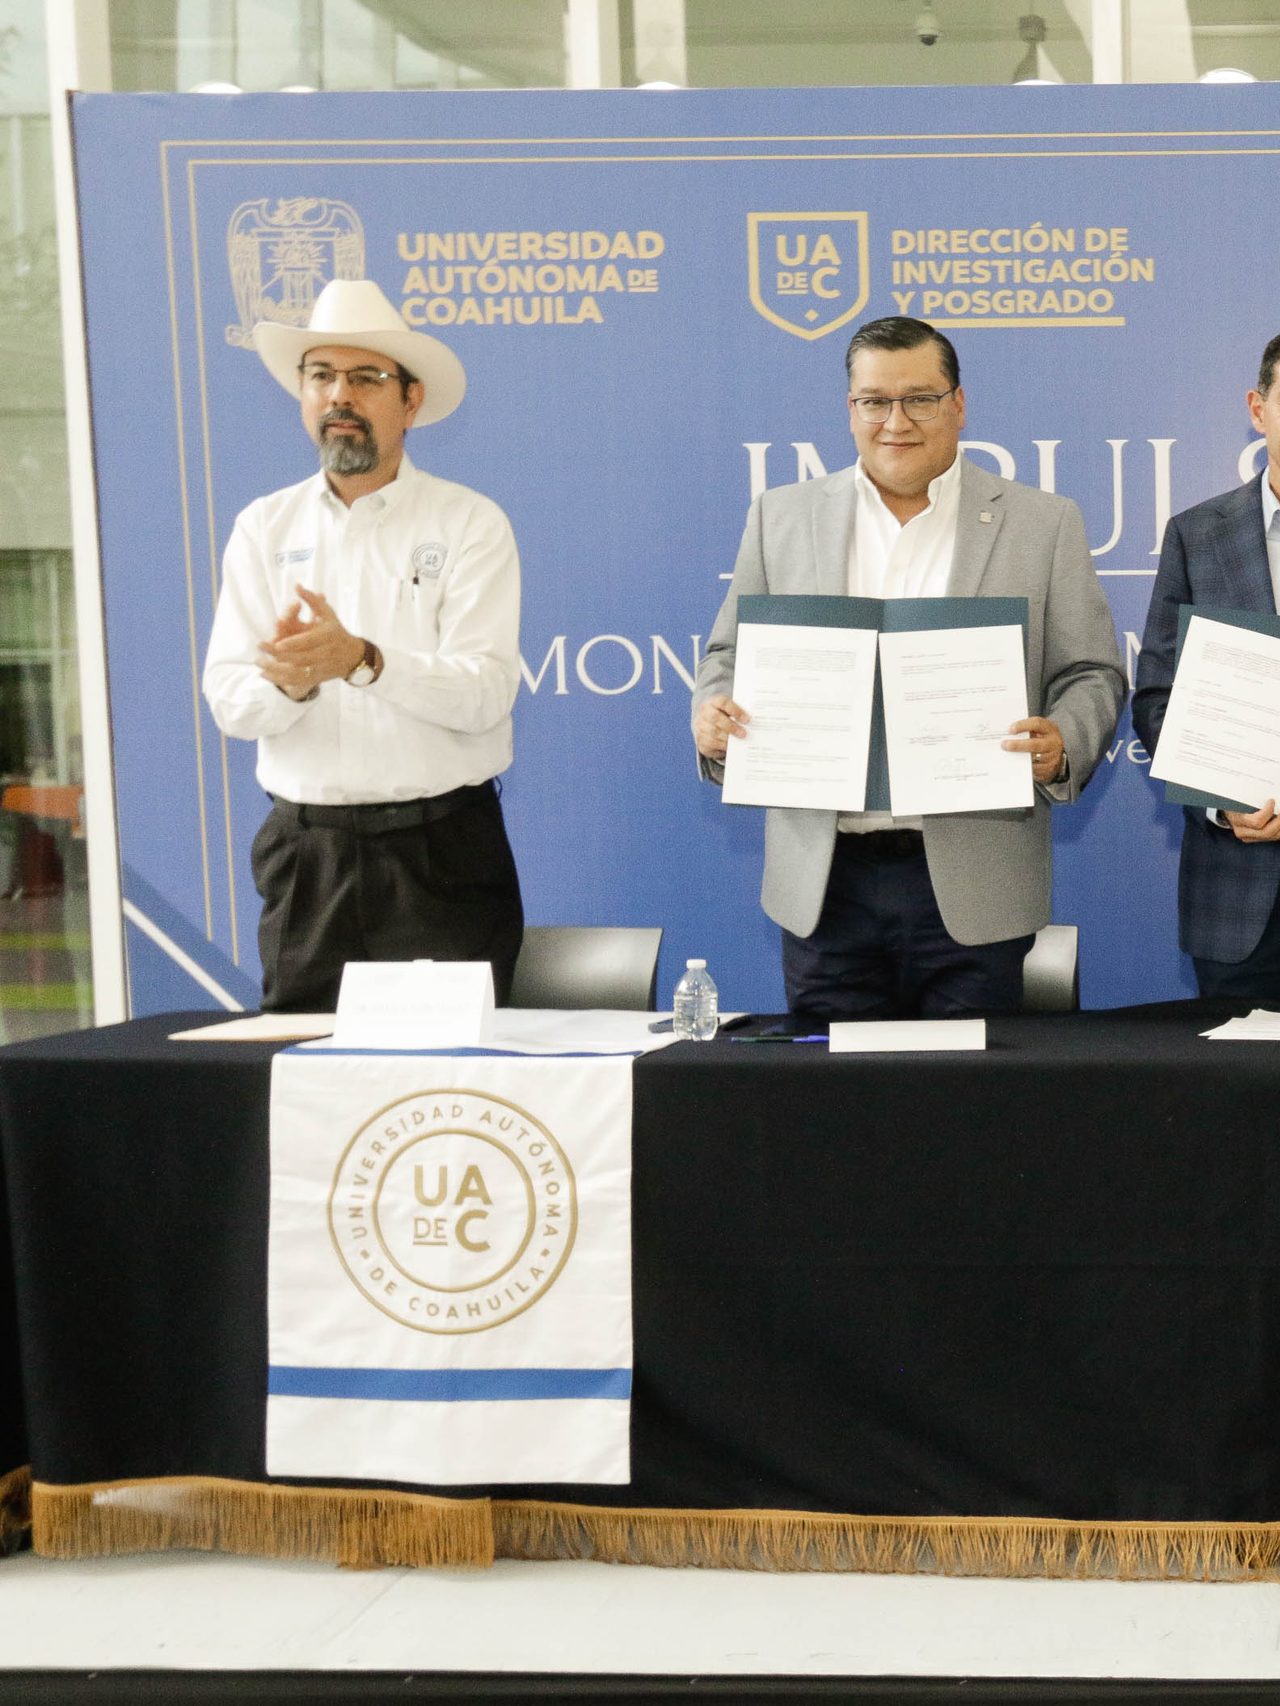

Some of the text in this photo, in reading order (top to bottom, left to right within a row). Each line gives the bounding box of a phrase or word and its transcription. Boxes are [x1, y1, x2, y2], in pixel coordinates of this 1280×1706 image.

[397, 231, 665, 261] UNIVERSIDAD
[776, 234, 841, 266] UA
[891, 222, 1129, 254] DIRECCIÓN DE
[402, 257, 659, 294] AUTÓNOMA DE
[776, 266, 842, 299] DE C
[892, 252, 1154, 284] INVESTIGACIÓN
[402, 296, 604, 326] COAHUILA
[891, 288, 1114, 315] Y POSGRADO
[348, 1104, 561, 1239] UNIVERSIDAD AUTÓNOMA
[414, 1164, 493, 1207] UA
[413, 1209, 491, 1253] DE C
[370, 1266, 544, 1319] DE COAHUILA
